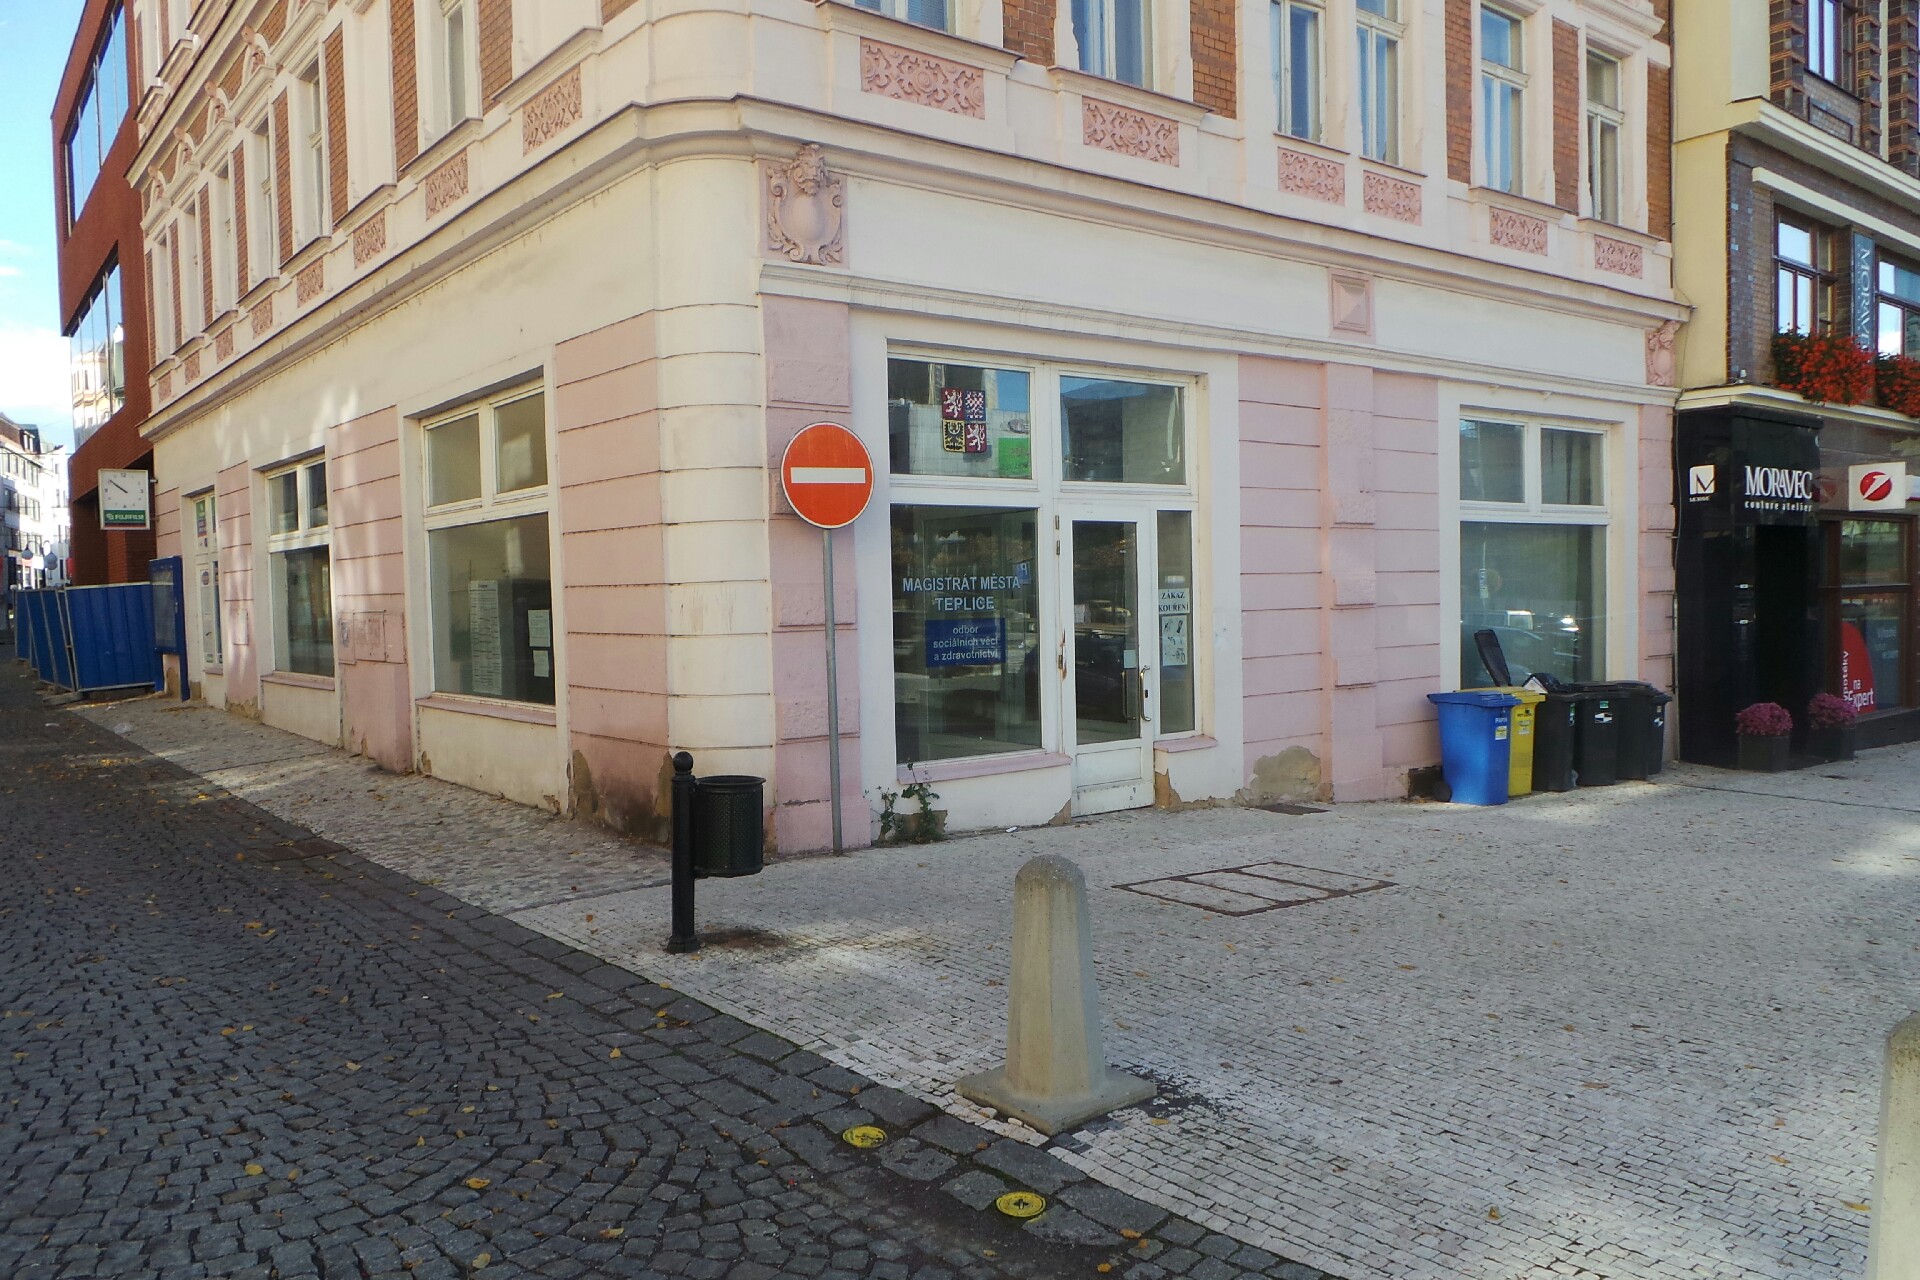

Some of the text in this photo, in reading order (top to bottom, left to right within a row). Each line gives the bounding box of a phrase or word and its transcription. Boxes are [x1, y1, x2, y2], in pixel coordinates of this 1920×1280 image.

[1861, 249, 1870, 350] MORAVE
[1744, 465, 1813, 499] MORAVEC
[1744, 499, 1813, 512] couture atelier
[903, 573, 1021, 592] MAGISTRÁT MĚSTA
[1161, 590, 1185, 600] ZÁKAZ
[935, 596, 995, 611] TEPLICE
[1158, 602, 1189, 612] KOUŘENÍ
[952, 624, 979, 635] odbor
[933, 636, 998, 649] sociálních věcí
[941, 648, 998, 661] zdravotnictví
[1848, 688, 1874, 712] Expert
